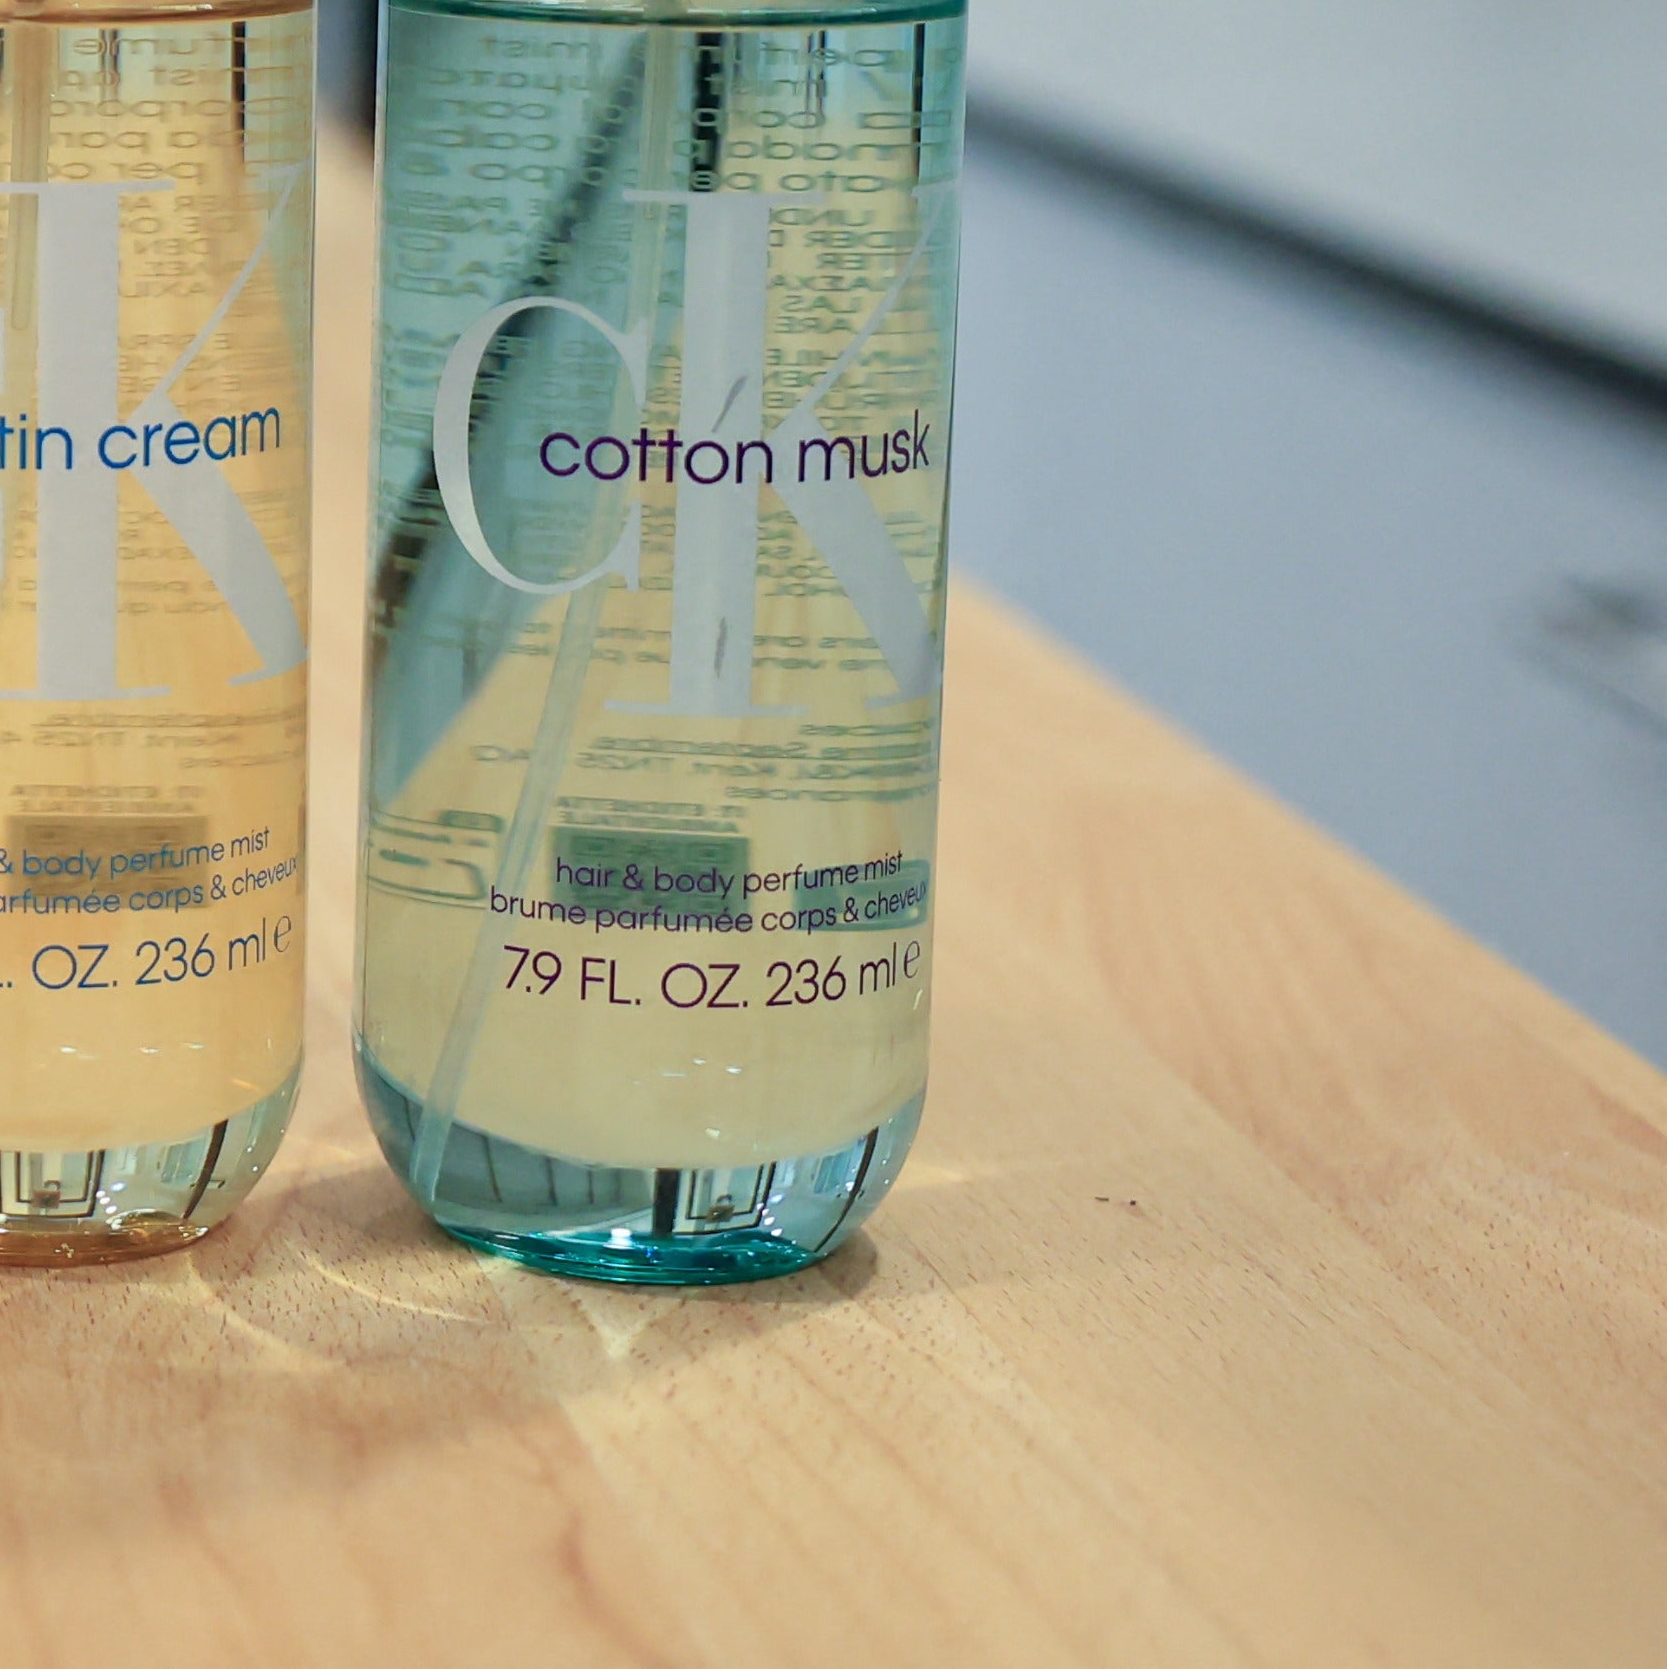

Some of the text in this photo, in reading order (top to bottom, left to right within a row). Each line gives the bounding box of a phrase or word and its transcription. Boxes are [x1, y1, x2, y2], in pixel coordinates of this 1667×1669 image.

[97, 406, 282, 470] cream
[539, 408, 932, 485] cotton musk
[21, 847, 101, 881] body
[109, 837, 225, 881] perfume
[229, 825, 271, 860] mist
[555, 848, 904, 901] hair & body perfume mist
[128, 880, 205, 914] corps
[209, 874, 228, 901] &
[230, 856, 299, 898] cheveux
[489, 885, 587, 926] brume
[594, 905, 754, 935] parfumée
[760, 902, 838, 936] corps
[841, 895, 861, 924] &
[31, 942, 119, 990] OZ.
[134, 931, 216, 986] 236
[227, 917, 267, 972] ml
[502, 943, 563, 997] 7.9
[580, 956, 643, 1007] FL.
[660, 961, 749, 1010] OZ.
[764, 954, 849, 1008] 236
[857, 940, 898, 997] ml
